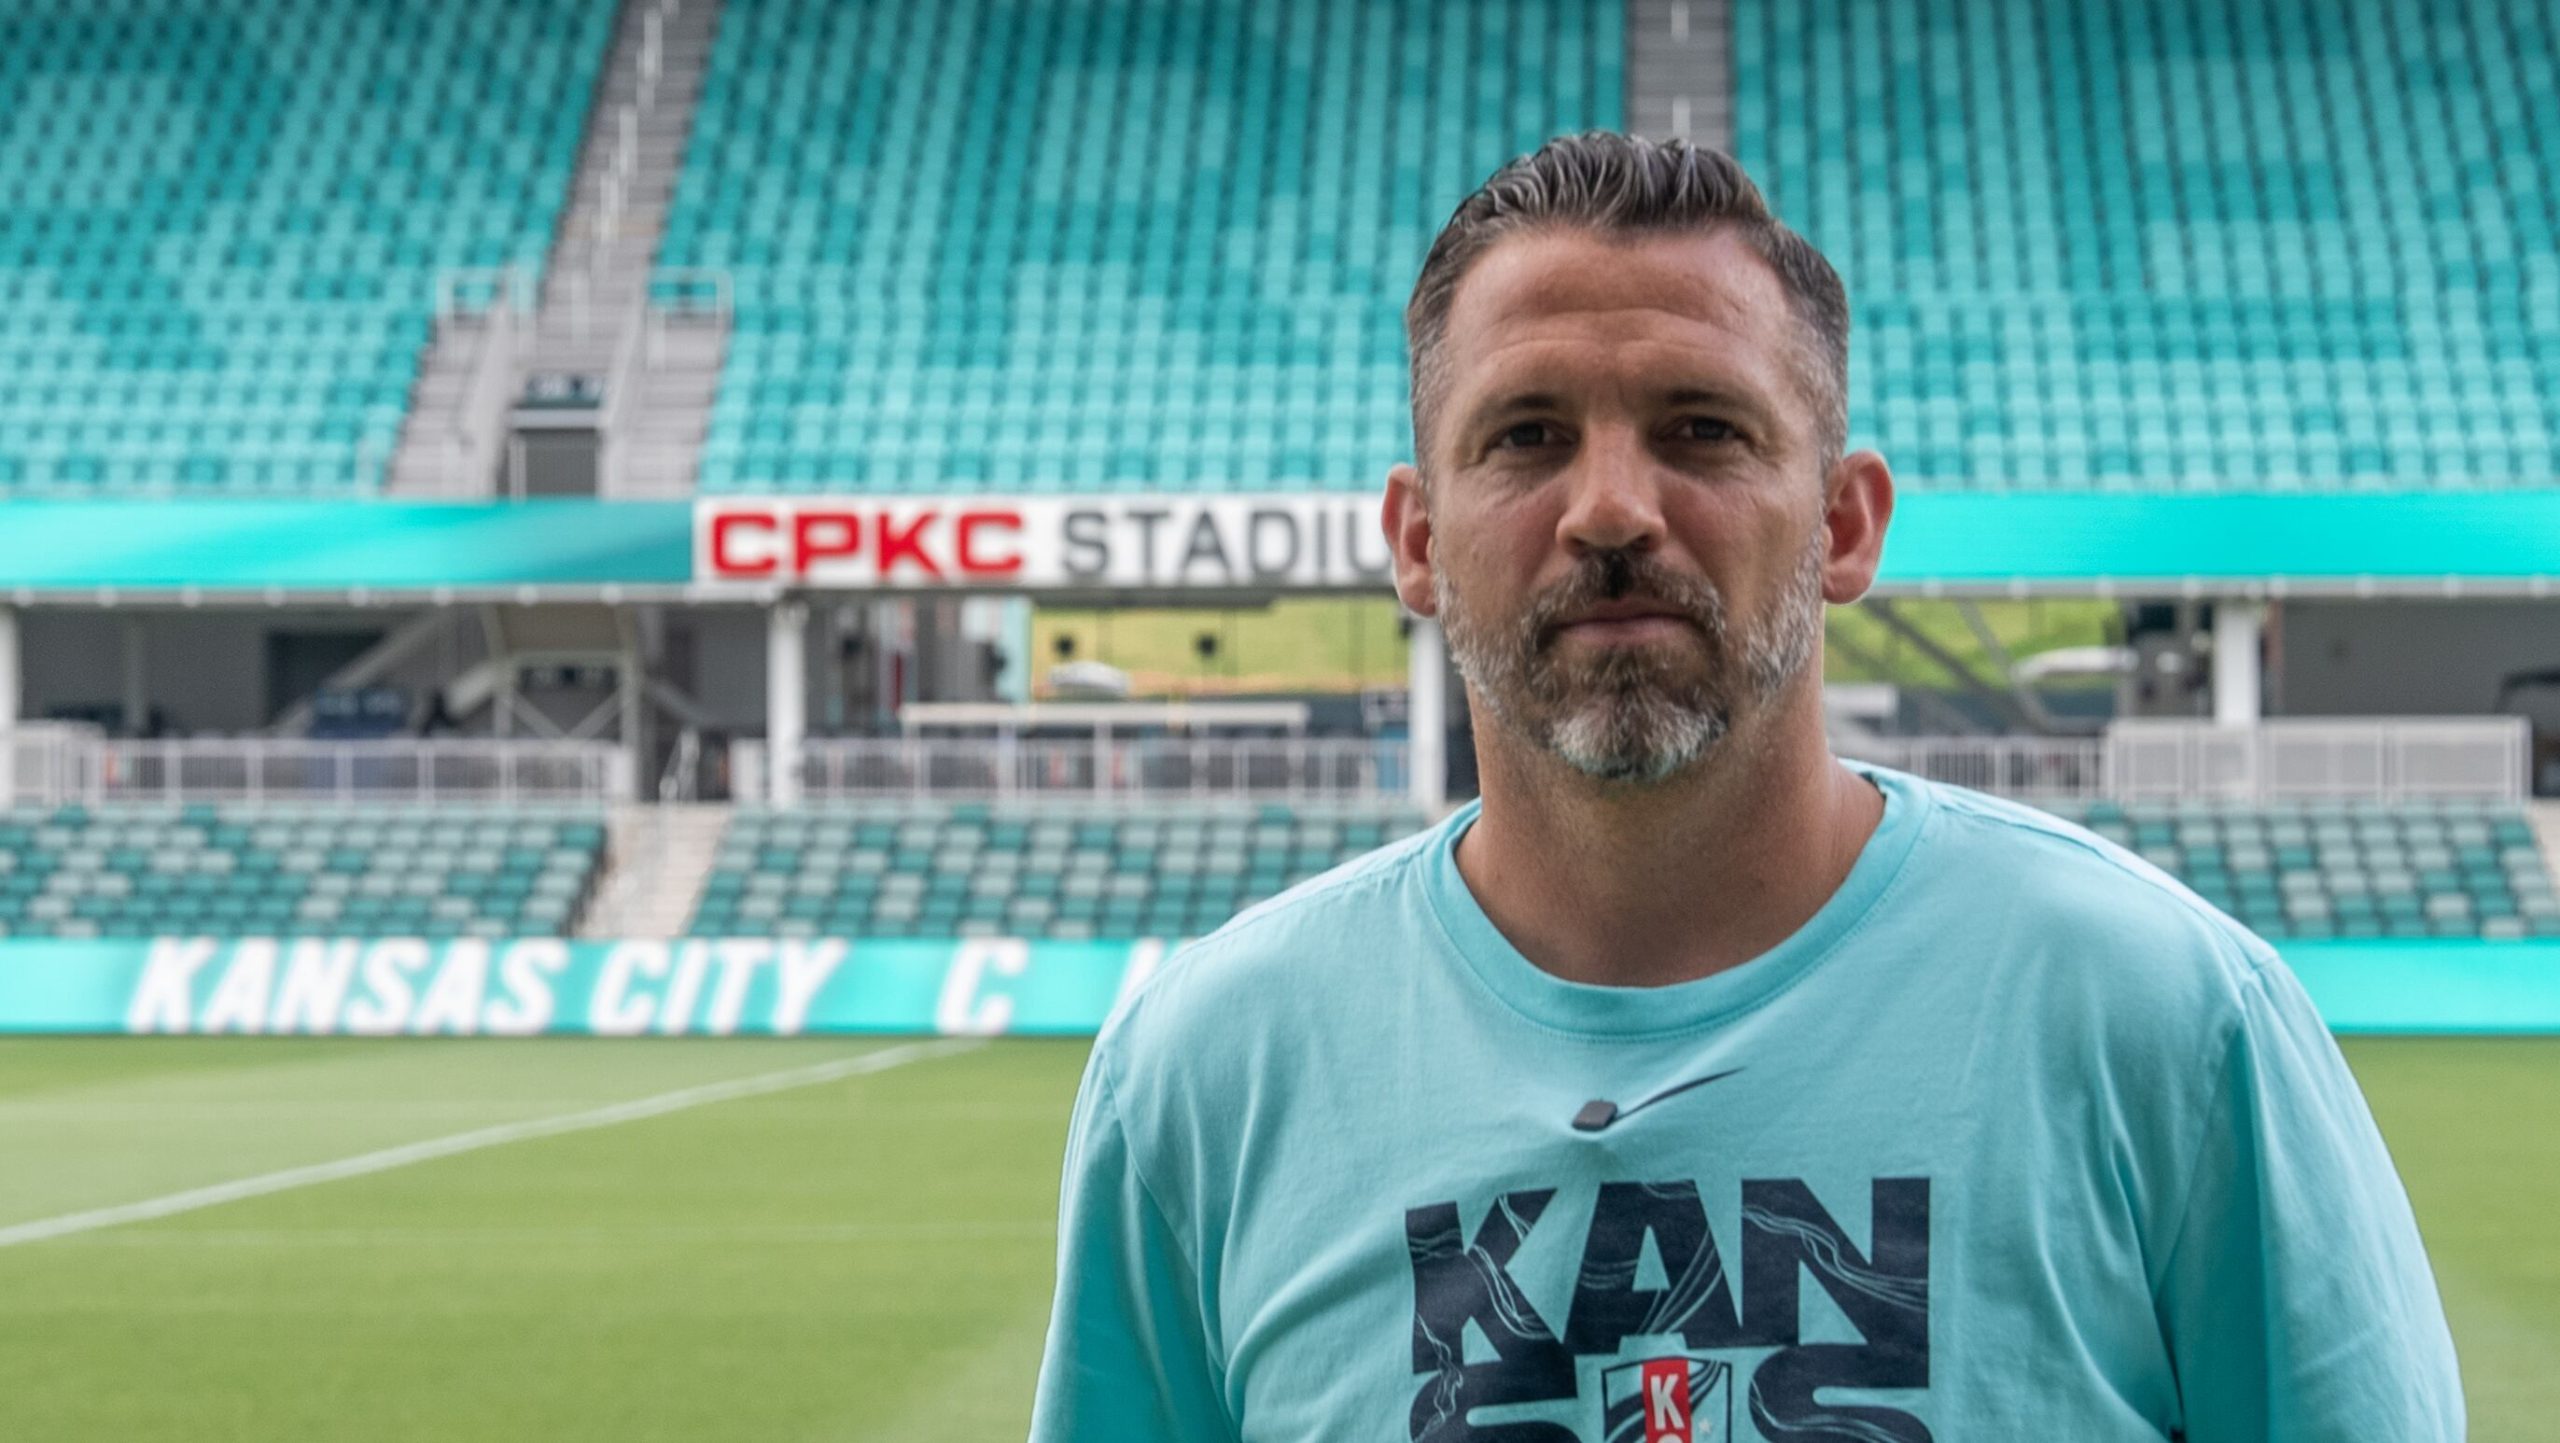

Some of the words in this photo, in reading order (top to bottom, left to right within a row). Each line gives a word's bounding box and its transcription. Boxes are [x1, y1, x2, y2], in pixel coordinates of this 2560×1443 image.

[711, 511, 1024, 576] CPKC
[127, 937, 568, 1034] KANSAS
[590, 937, 846, 1034] CITY
[1405, 1177, 1930, 1374] KAN
